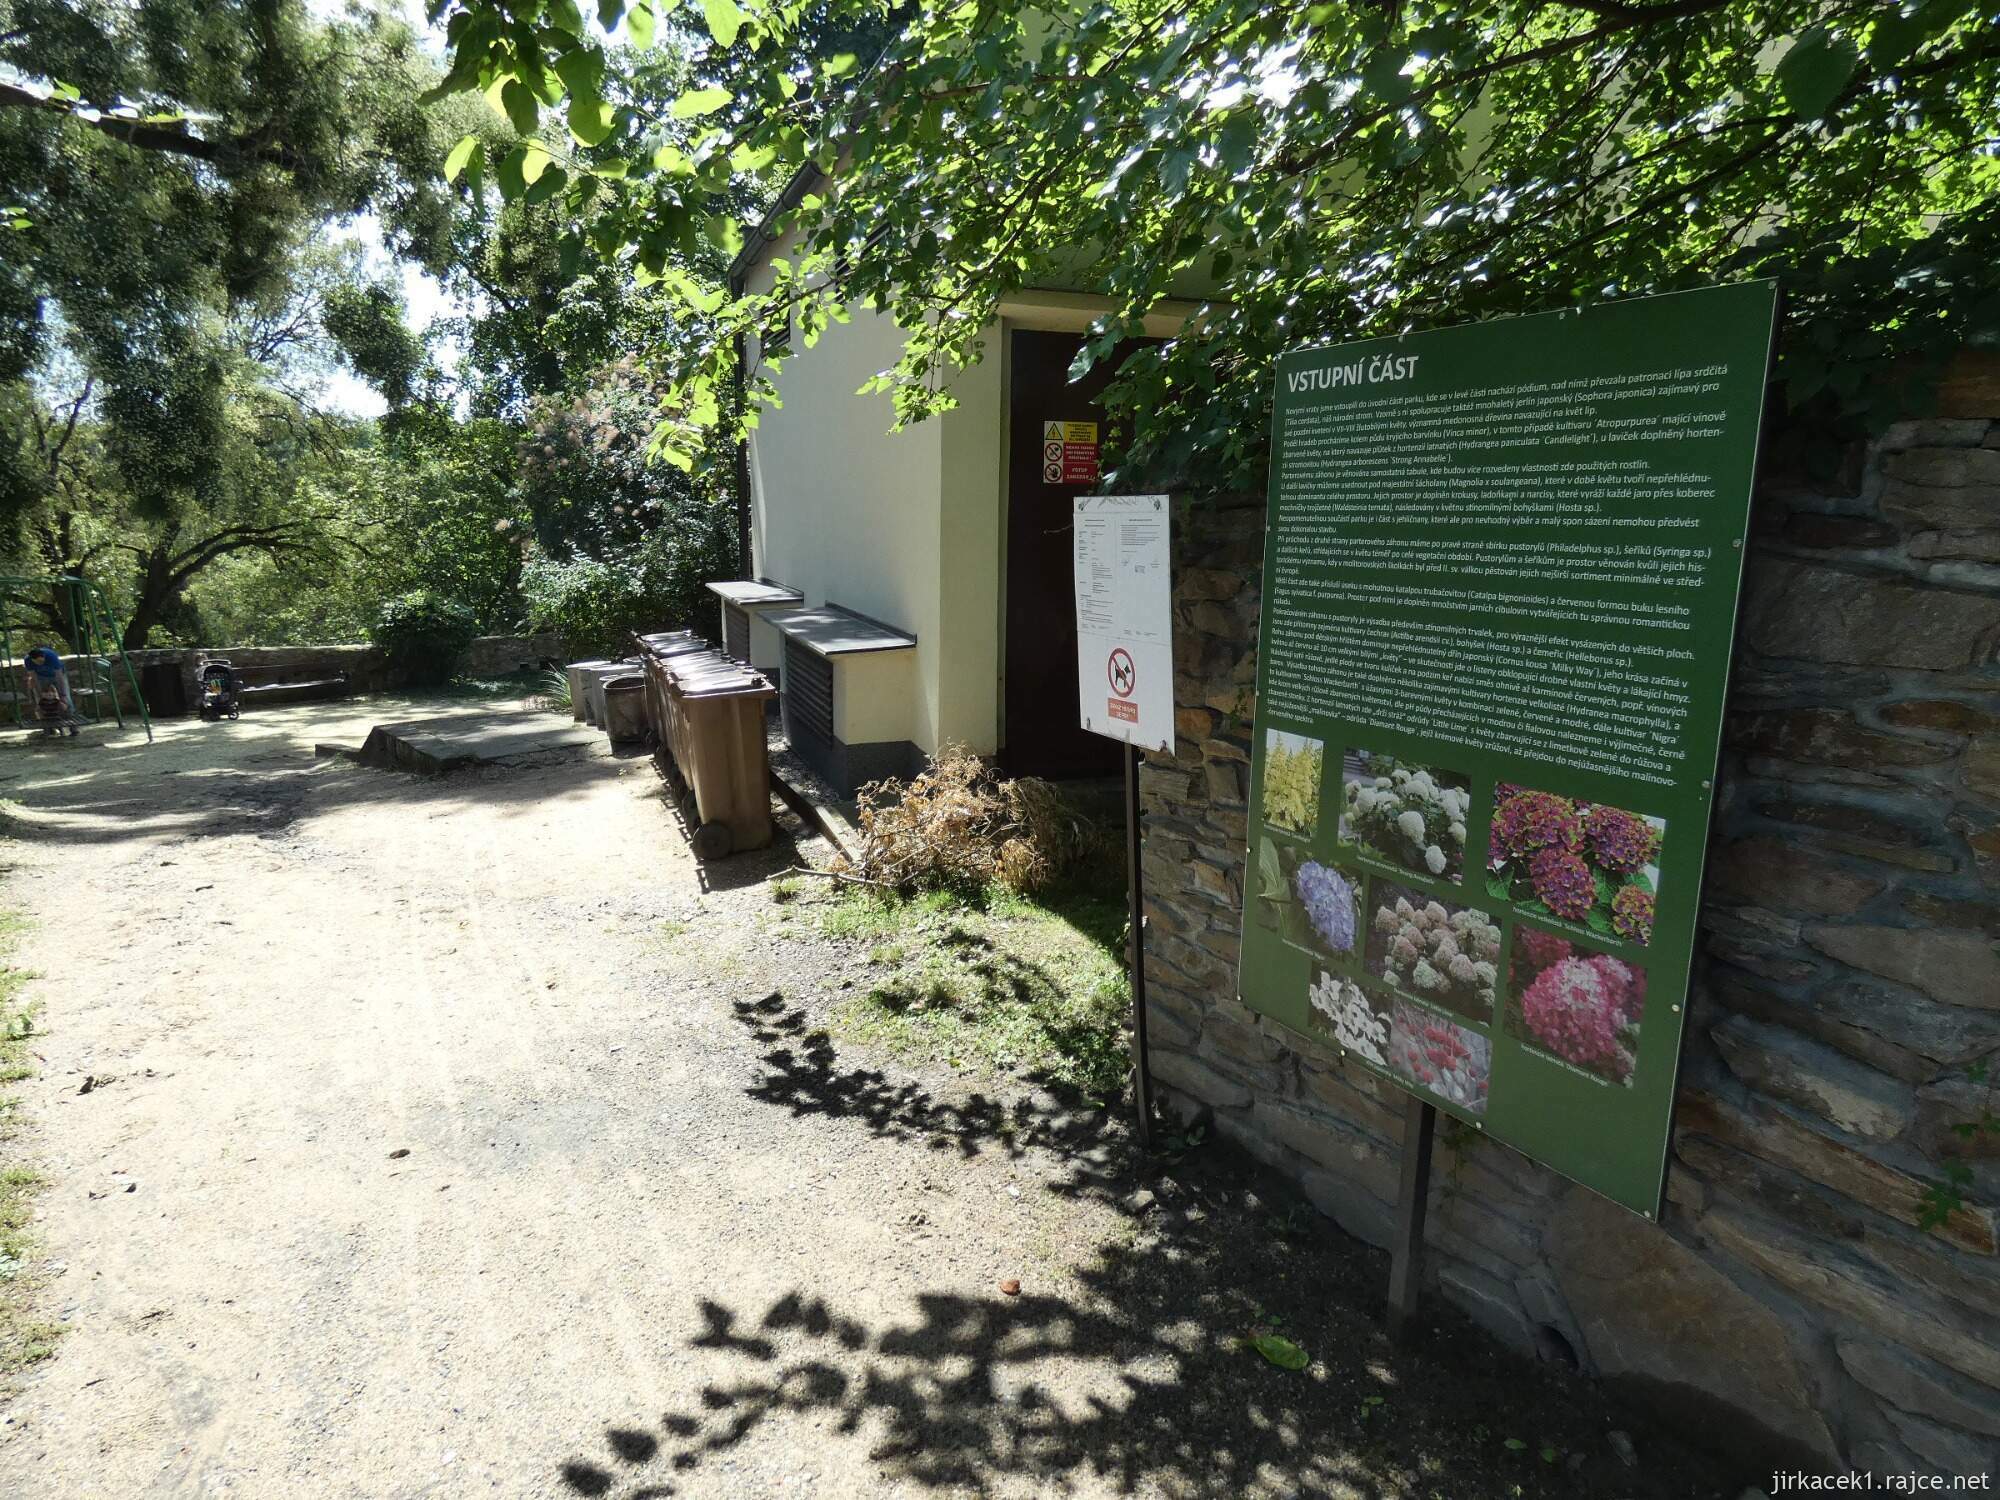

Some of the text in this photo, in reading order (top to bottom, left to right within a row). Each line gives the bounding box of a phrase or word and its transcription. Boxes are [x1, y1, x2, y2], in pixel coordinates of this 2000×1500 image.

[1288, 353, 1419, 393] VSTUPNÍ ČÁST
[1567, 377, 1588, 388] nímž
[1589, 374, 1626, 389] převzala
[1673, 368, 1691, 380] lípa
[1693, 363, 1728, 376] srdčitá
[1657, 382, 1700, 397] zajímavý
[1701, 383, 1719, 394] pro
[1564, 406, 1583, 416] květ
[1661, 412, 1691, 425] mající
[1692, 410, 1727, 422] vínově
[1640, 427, 1684, 441] doplněný
[1685, 426, 1724, 437] horten-
[1559, 461, 1574, 471] zde
[1575, 460, 1618, 472] použitých
[1573, 474, 1595, 484] době
[1596, 474, 1621, 483] květu
[1646, 472, 1711, 485] nepřehlédnu-
[1556, 489, 1579, 498] které
[1580, 488, 1605, 500] vyráží
[1606, 488, 1631, 497] každé
[1632, 488, 1652, 500] jaro
[1652, 488, 1674, 500] přes
[1676, 487, 1715, 497] koberec
[1561, 518, 1582, 527] spon
[1583, 516, 1611, 525] sázení
[1611, 516, 1655, 526] nemohou
[1656, 517, 1700, 529] předvést
[1623, 545, 1652, 555] šeříků
[1555, 556, 1564, 567] je
[1565, 557, 1596, 568] prostor
[1597, 558, 1635, 568] věnován
[1636, 559, 1659, 569] kvůli
[1659, 560, 1686, 572] jejich
[1687, 561, 1705, 571] his-
[1570, 571, 1612, 581] sortiment
[1613, 573, 1661, 584] minimálně
[1662, 577, 1674, 585] ve
[1675, 576, 1704, 586] střed-
[1556, 596, 1595, 608] červenou
[1596, 599, 1629, 610] formou
[1630, 601, 1653, 612] buku
[1654, 603, 1690, 615] lesního
[1579, 611, 1589, 620] tu
[1590, 613, 1630, 624] správnou
[1631, 617, 1690, 629] romantickou
[1547, 635, 1569, 646] efekt
[1569, 638, 1617, 652] vysázených
[1618, 642, 1630, 652] do
[1632, 644, 1664, 656] větších
[1602, 668, 1623, 680] jeho
[1624, 671, 1648, 683] krása
[1650, 675, 1680, 687] začíná
[1539, 673, 1568, 685] drobné
[1568, 678, 1596, 689] vlastní
[1597, 681, 1621, 695] květy
[1630, 685, 1662, 699] lákající
[1645, 702, 1688, 718] vínových
[1557, 729, 1601, 744] nalezneme
[1592, 721, 1612, 733] dále
[1612, 724, 1646, 739] kultivar
[1548, 739, 1588, 755] limetkově
[1589, 749, 1618, 761] zelené
[1619, 752, 1631, 763] do
[1632, 755, 1663, 770] růžova
[1555, 754, 1566, 764] do
[1567, 758, 1629, 777] nejúžasnějšího
[1631, 771, 1677, 786] malinovo-
